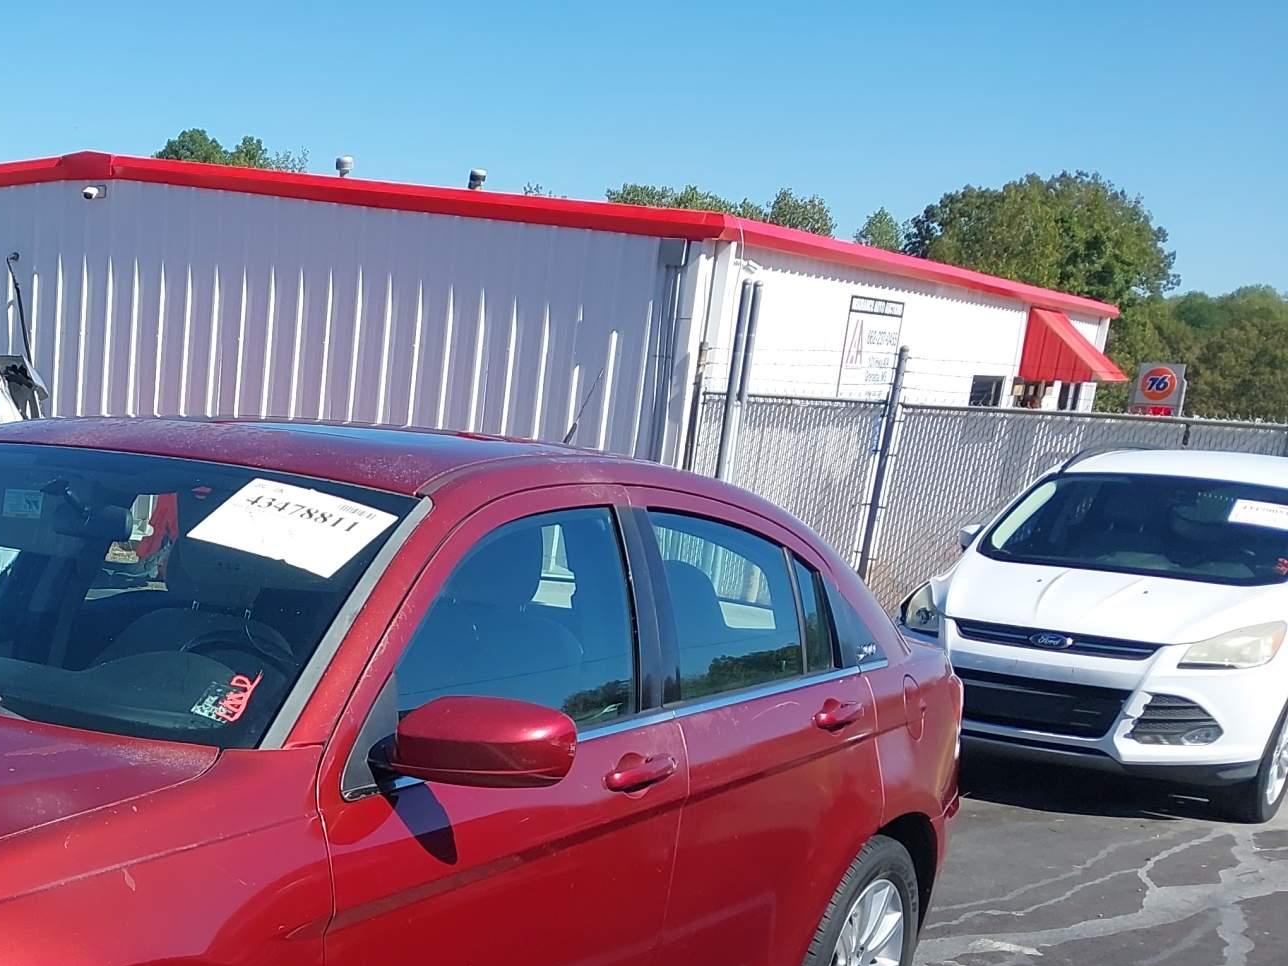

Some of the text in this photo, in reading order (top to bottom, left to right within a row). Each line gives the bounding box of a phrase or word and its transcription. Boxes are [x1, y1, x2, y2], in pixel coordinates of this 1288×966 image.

[1146, 374, 1171, 393] 76
[246, 495, 360, 532] 43478811
[1038, 634, 1062, 646] Ford
